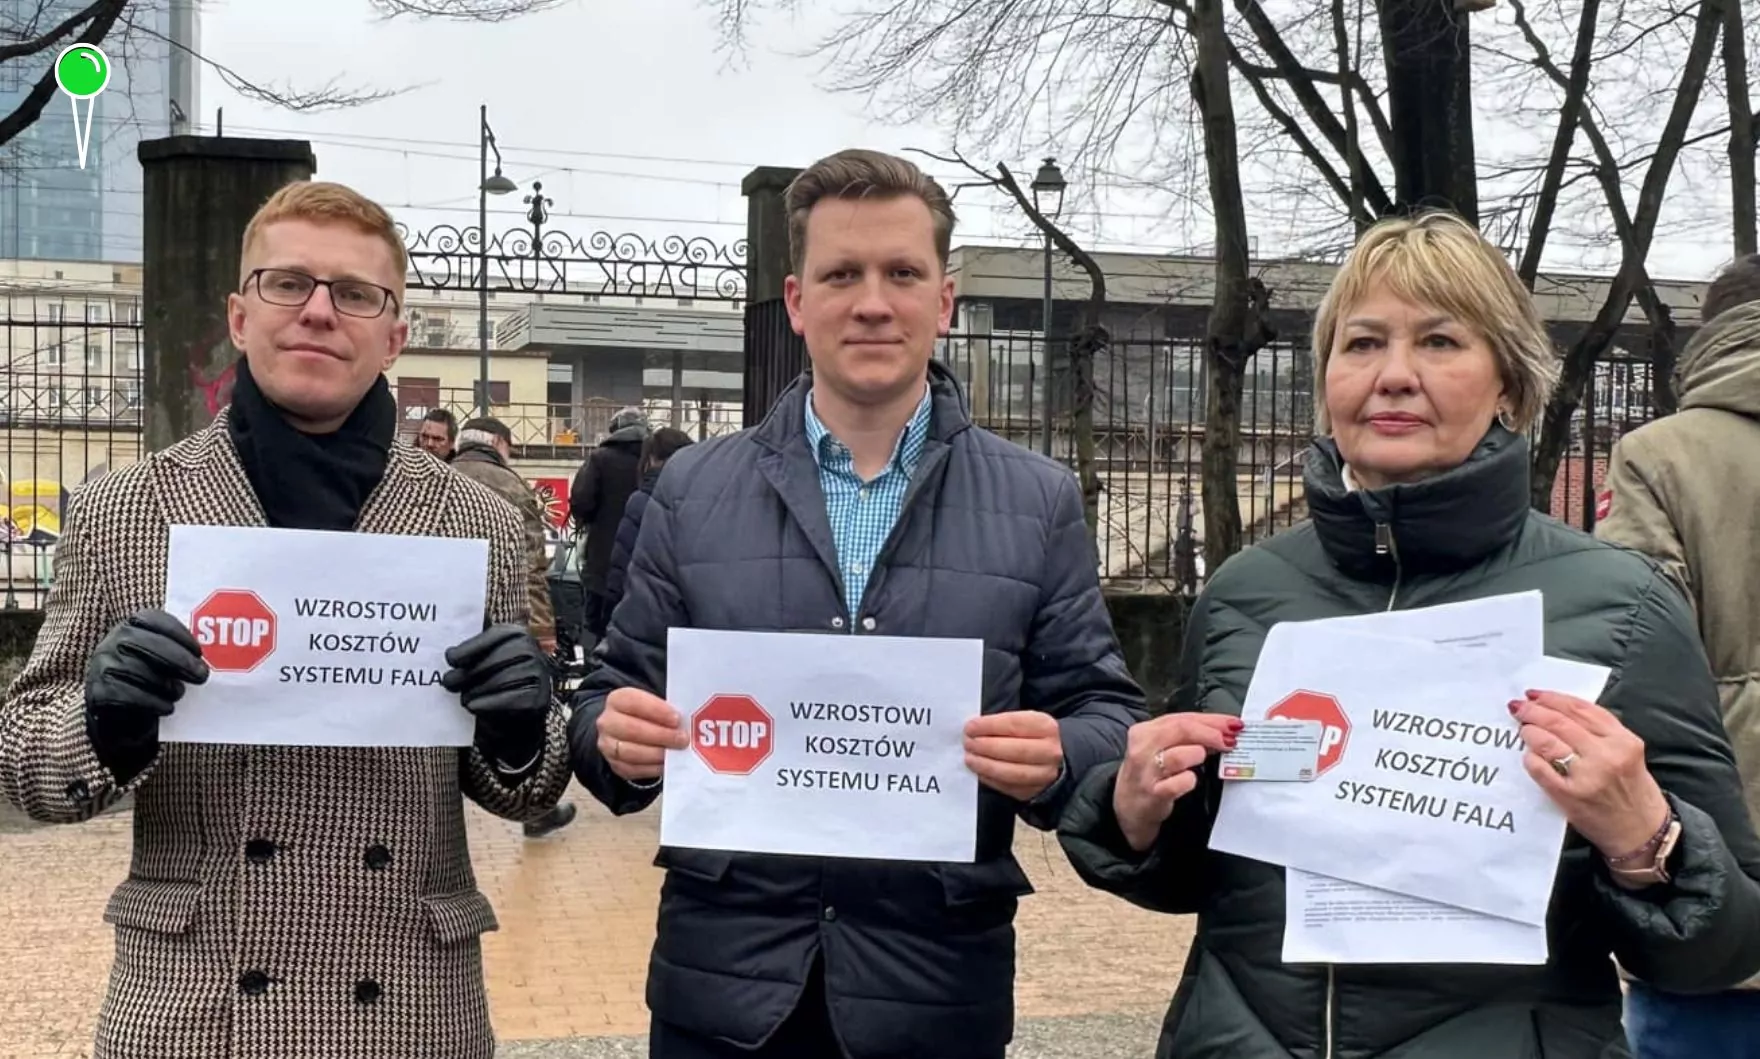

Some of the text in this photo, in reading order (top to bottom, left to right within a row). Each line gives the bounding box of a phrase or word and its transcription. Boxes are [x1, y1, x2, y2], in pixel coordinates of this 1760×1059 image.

[294, 598, 437, 622] WZROSTOWI
[197, 616, 270, 648] STOP
[309, 631, 420, 654] KOSZTÓW
[279, 665, 442, 686] SYSTEMU FALA
[790, 701, 932, 726] WZROSTOWI
[699, 720, 767, 749] STOP
[805, 735, 916, 758] KOSZTÓW
[1374, 747, 1500, 787] KOSZTÓW
[777, 768, 941, 794] SYSTEMU FALA
[1334, 780, 1516, 834] SYSTEMU FALA
